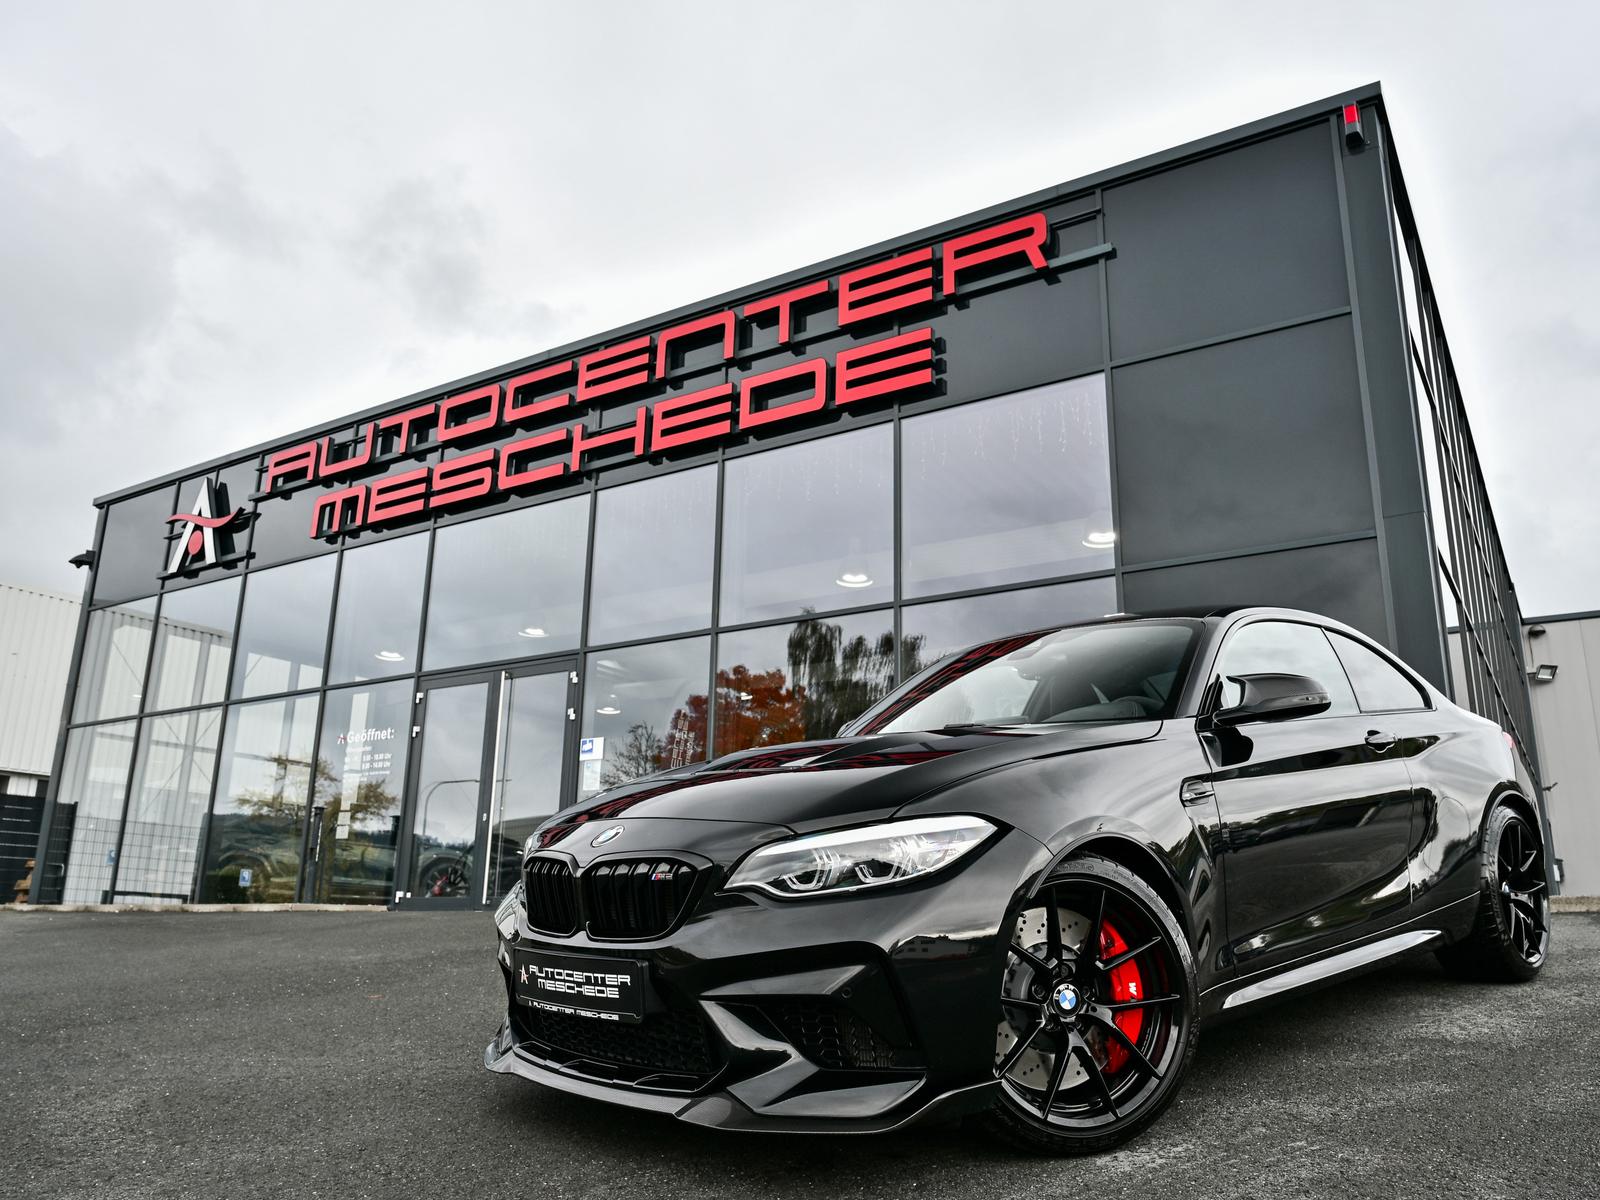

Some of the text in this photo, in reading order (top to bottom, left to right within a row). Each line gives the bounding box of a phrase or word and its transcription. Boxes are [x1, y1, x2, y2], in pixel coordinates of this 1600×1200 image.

[265, 213, 1048, 494] AUTOCENTER
[309, 328, 932, 539] MESCHEDE
[347, 727, 395, 743] Geöffnet:
[529, 964, 631, 986] AUTOCENTER
[537, 979, 620, 998] MESCHEDE
